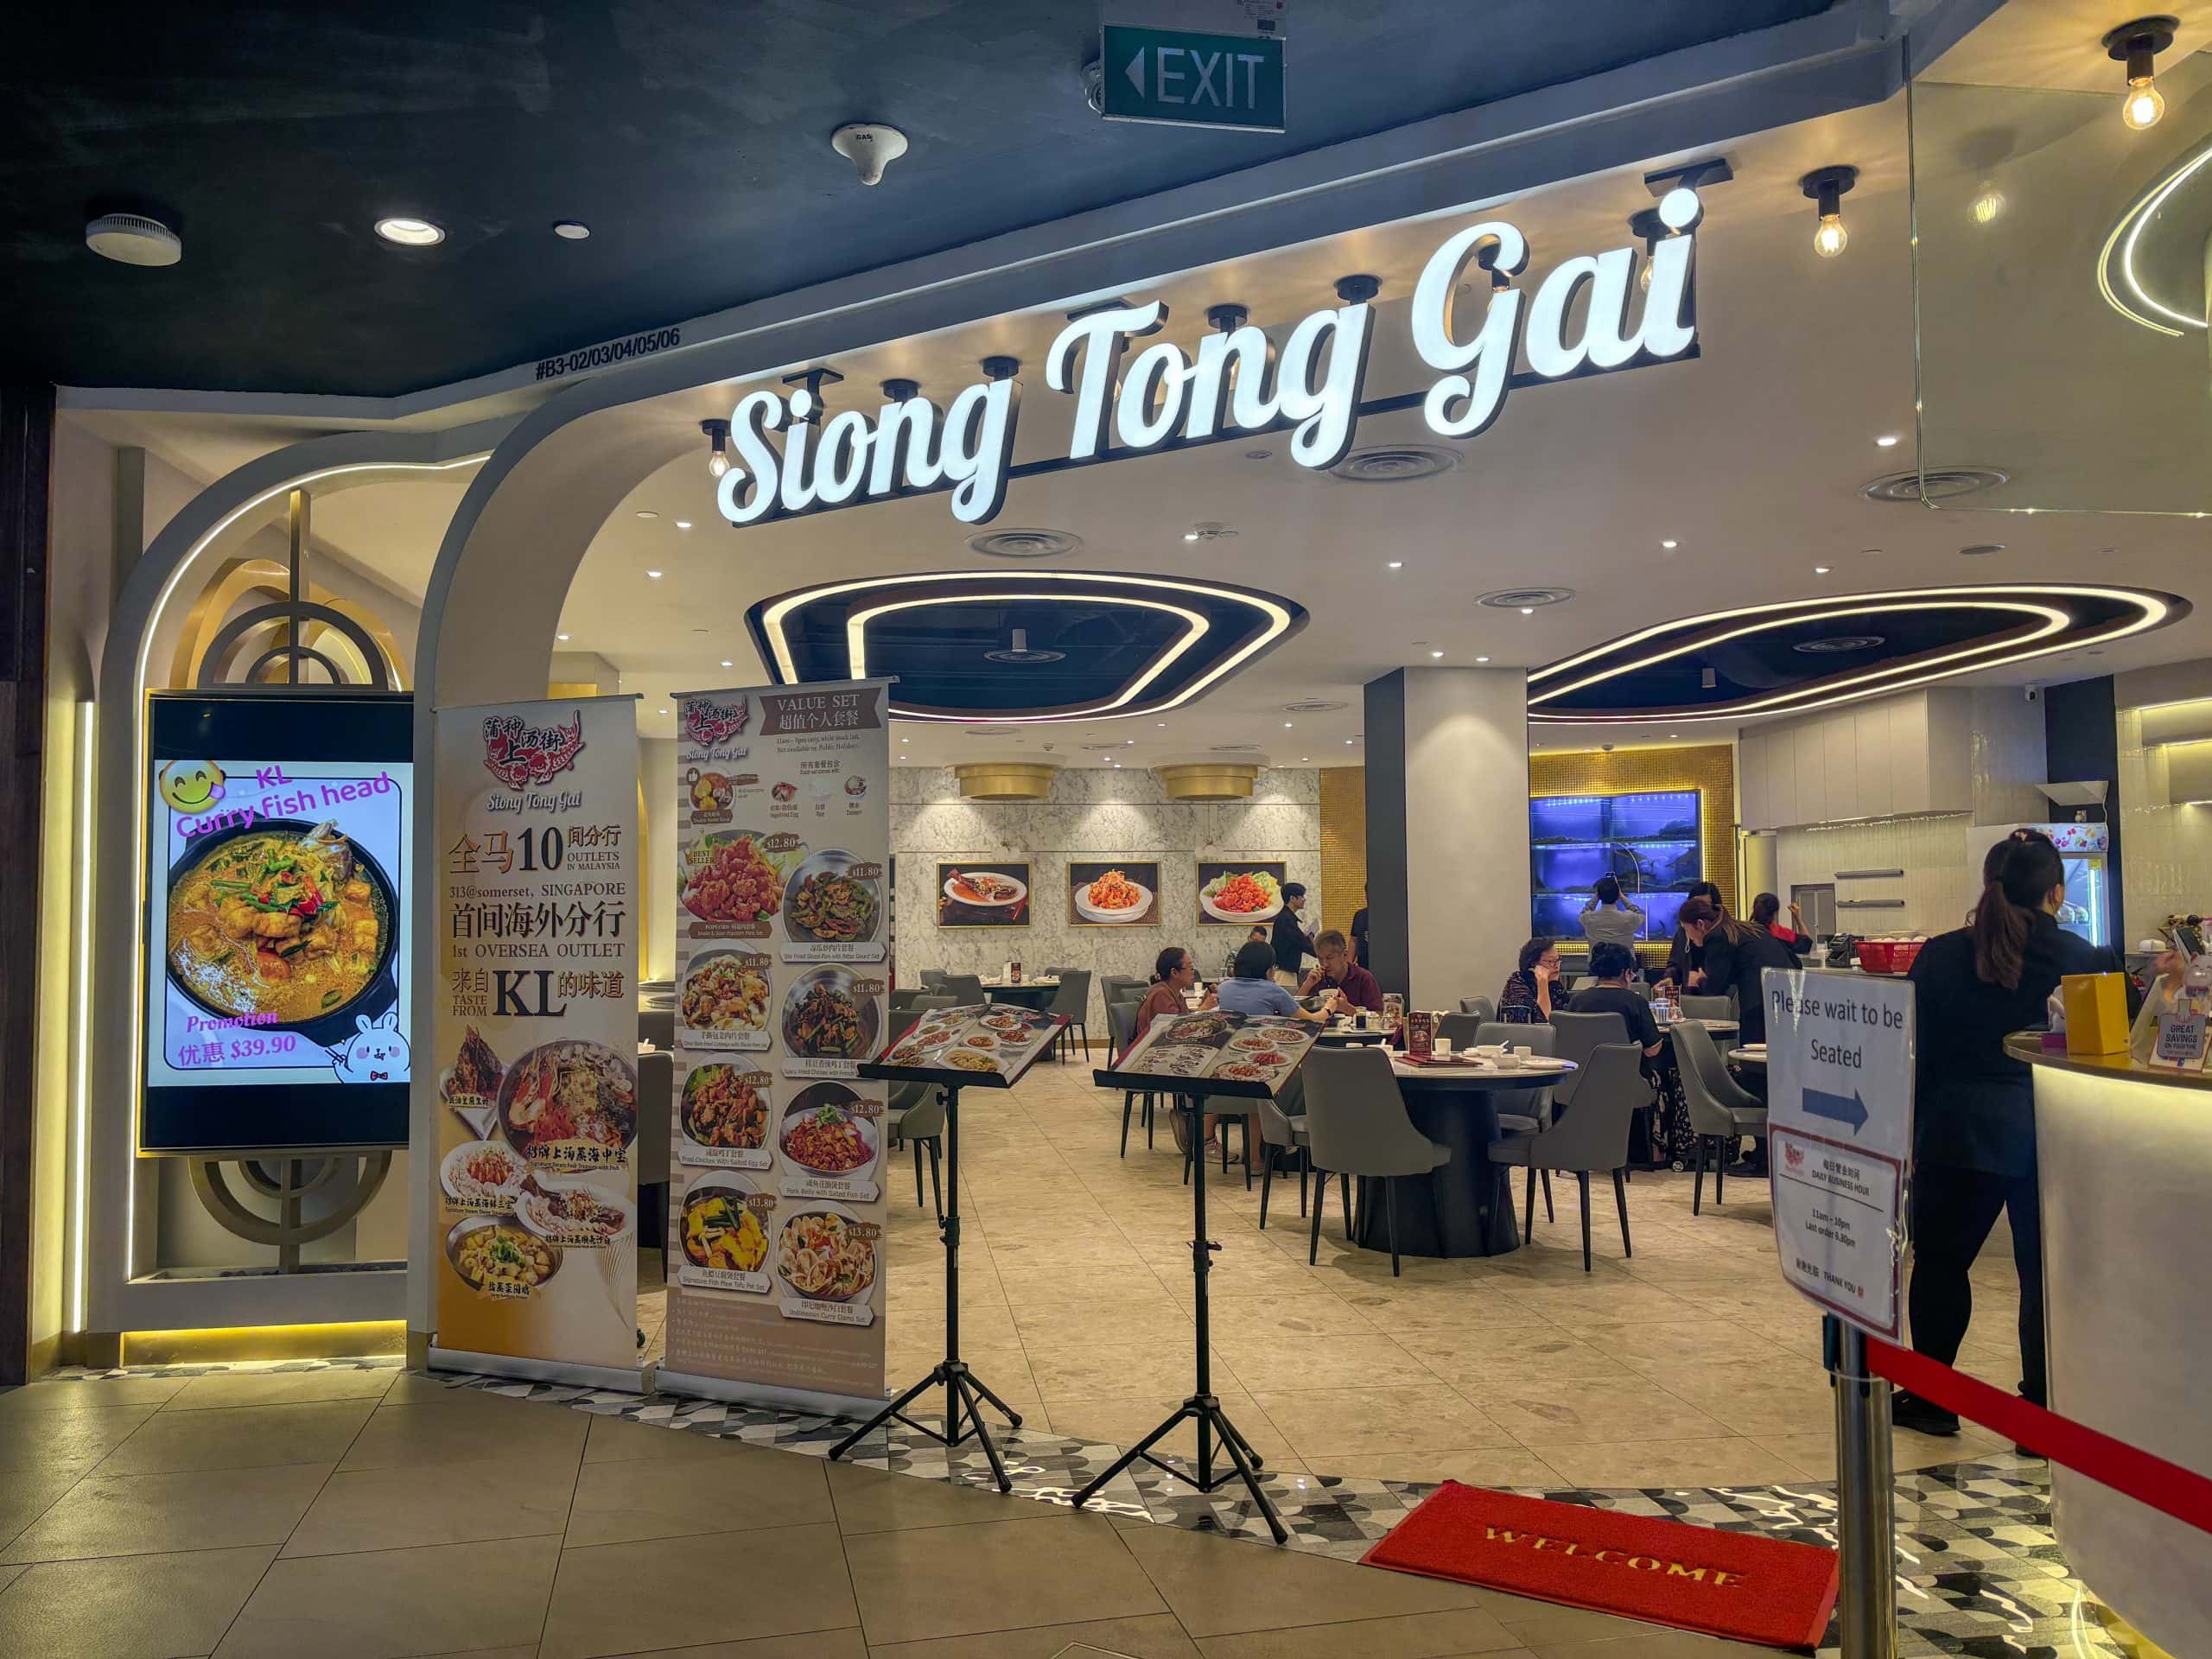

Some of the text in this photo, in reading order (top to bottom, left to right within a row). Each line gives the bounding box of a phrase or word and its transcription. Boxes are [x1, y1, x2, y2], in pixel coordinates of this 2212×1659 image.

[1157, 46, 1265, 110] EXIT
[536, 327, 680, 380] #B3-02/03/04/05/06
[717, 188, 1704, 524] Siong Tong Gai
[778, 694, 860, 711] VALUE SET
[779, 710, 859, 730] 超值个人套餐
[256, 765, 293, 790] KL
[176, 771, 391, 839] Curry fish head
[486, 790, 581, 814] Siong Tong Gai
[449, 825, 621, 874] 全马 10 间分行
[766, 837, 796, 849] $12.80
[567, 852, 620, 861] OUTLETS
[577, 861, 620, 871] MALAYSIA
[449, 883, 626, 899] 313@somerset, SINGAPORE
[449, 901, 626, 939] 首间海外分行
[453, 943, 626, 957] 1st OVERSEA OUTLET
[451, 967, 625, 1017] 来自 KL 的味道
[452, 995, 487, 1005] TASTE
[853, 984, 880, 994] $11.80
[186, 1010, 278, 1033] Promotion
[452, 1006, 487, 1017] FROM
[1825, 999, 1857, 1022] wait
[1862, 1003, 1878, 1025] to
[1884, 1004, 1903, 1029] be
[2165, 1033, 2198, 1043] SAVINGS
[2171, 1024, 2194, 1033] GREAT
[179, 1035, 296, 1066] 优惠 $39.90
[1811, 1039, 1862, 1069] Seated
[744, 1075, 769, 1085] $12.80
[851, 1104, 880, 1115] $12.80
[1812, 1169, 1870, 1197] DAILY BUSINESS HOUR
[1806, 1220, 1817, 1232] Last
[1817, 1226, 1834, 1239] order
[1813, 1209, 1828, 1222] 11am
[1834, 1217, 1851, 1231] 10pm
[849, 1228, 877, 1237] $13.80
[1824, 1270, 1856, 1294] THANK YOU
[1484, 1524, 1748, 1588] WELCOME
